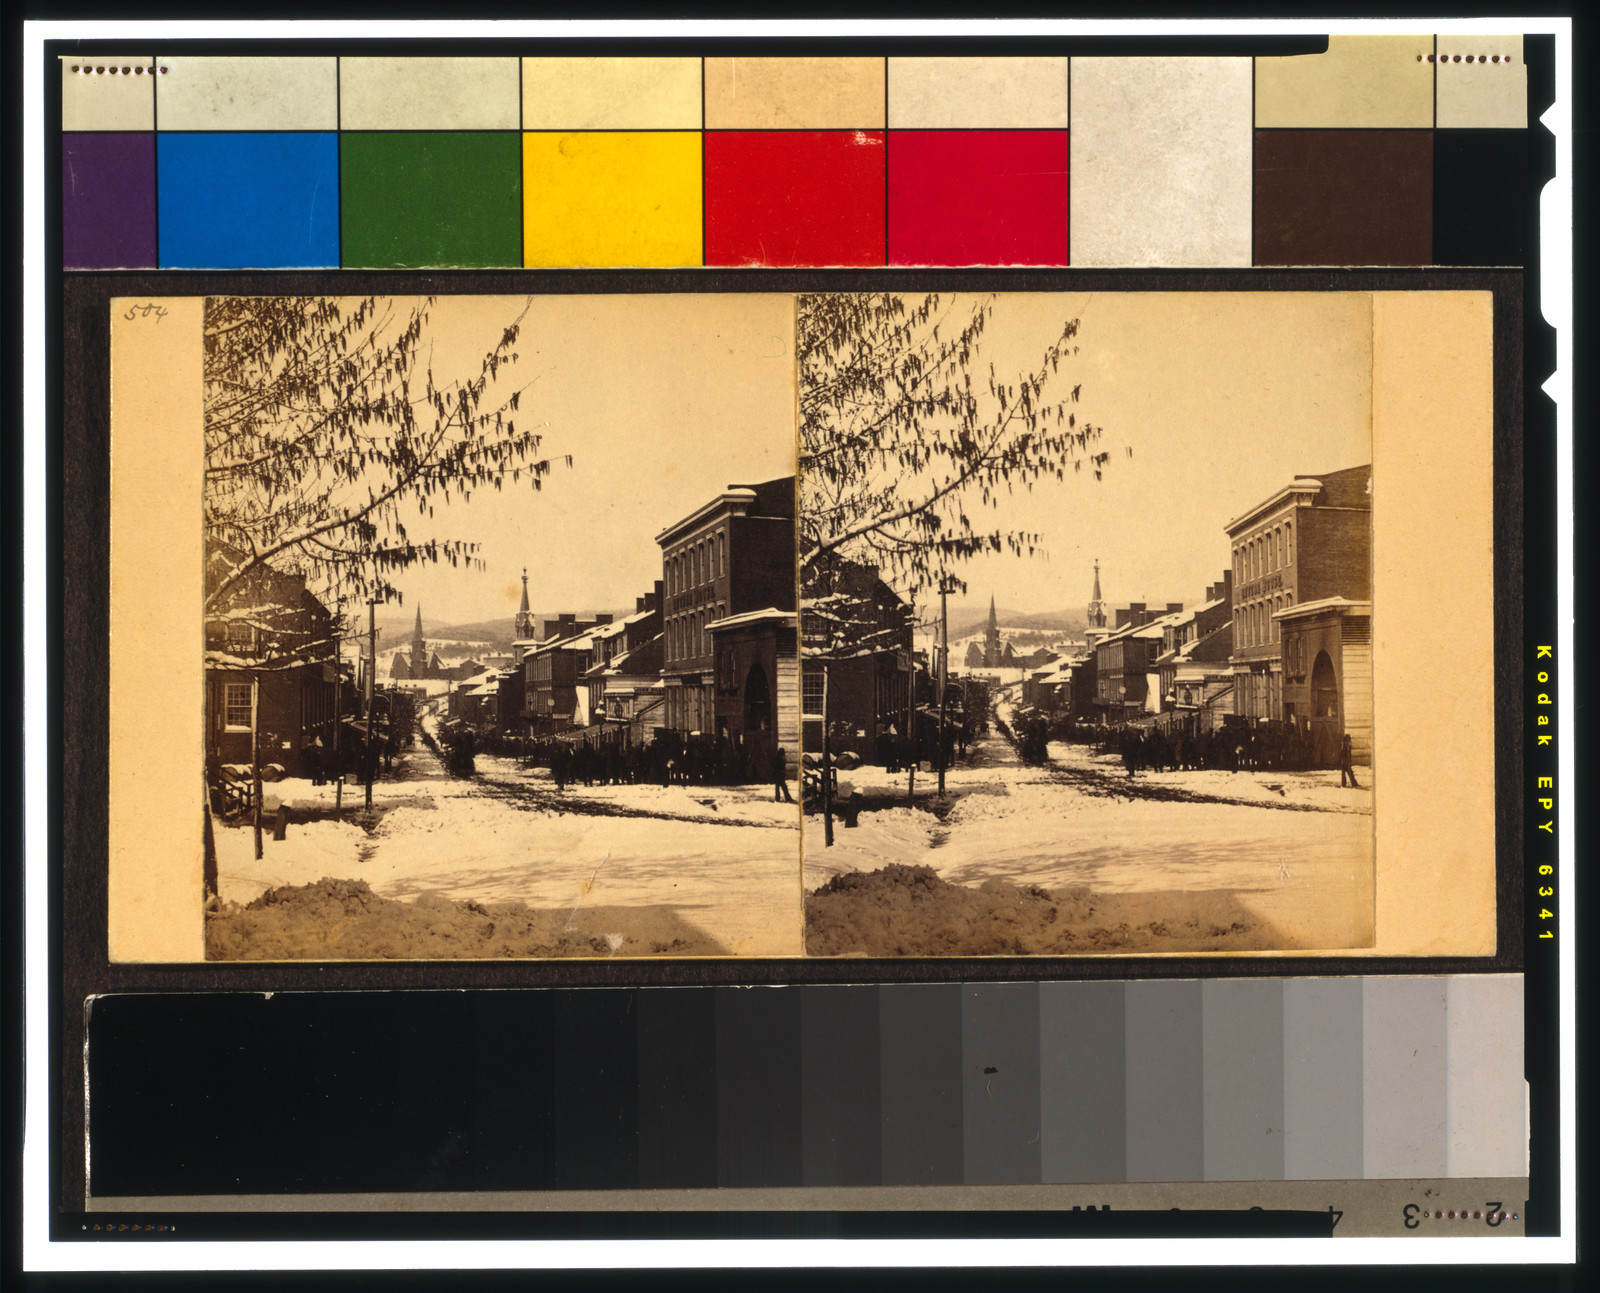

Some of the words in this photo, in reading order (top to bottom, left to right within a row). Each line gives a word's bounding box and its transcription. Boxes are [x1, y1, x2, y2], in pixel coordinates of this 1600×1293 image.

[123, 303, 169, 324] 504
[1537, 645, 1553, 746] Kodak
[1538, 776, 1553, 834] EPY
[1538, 864, 1554, 939] 6341
[1403, 1203, 1420, 1229] 3
[1485, 1202, 1502, 1227] 2
